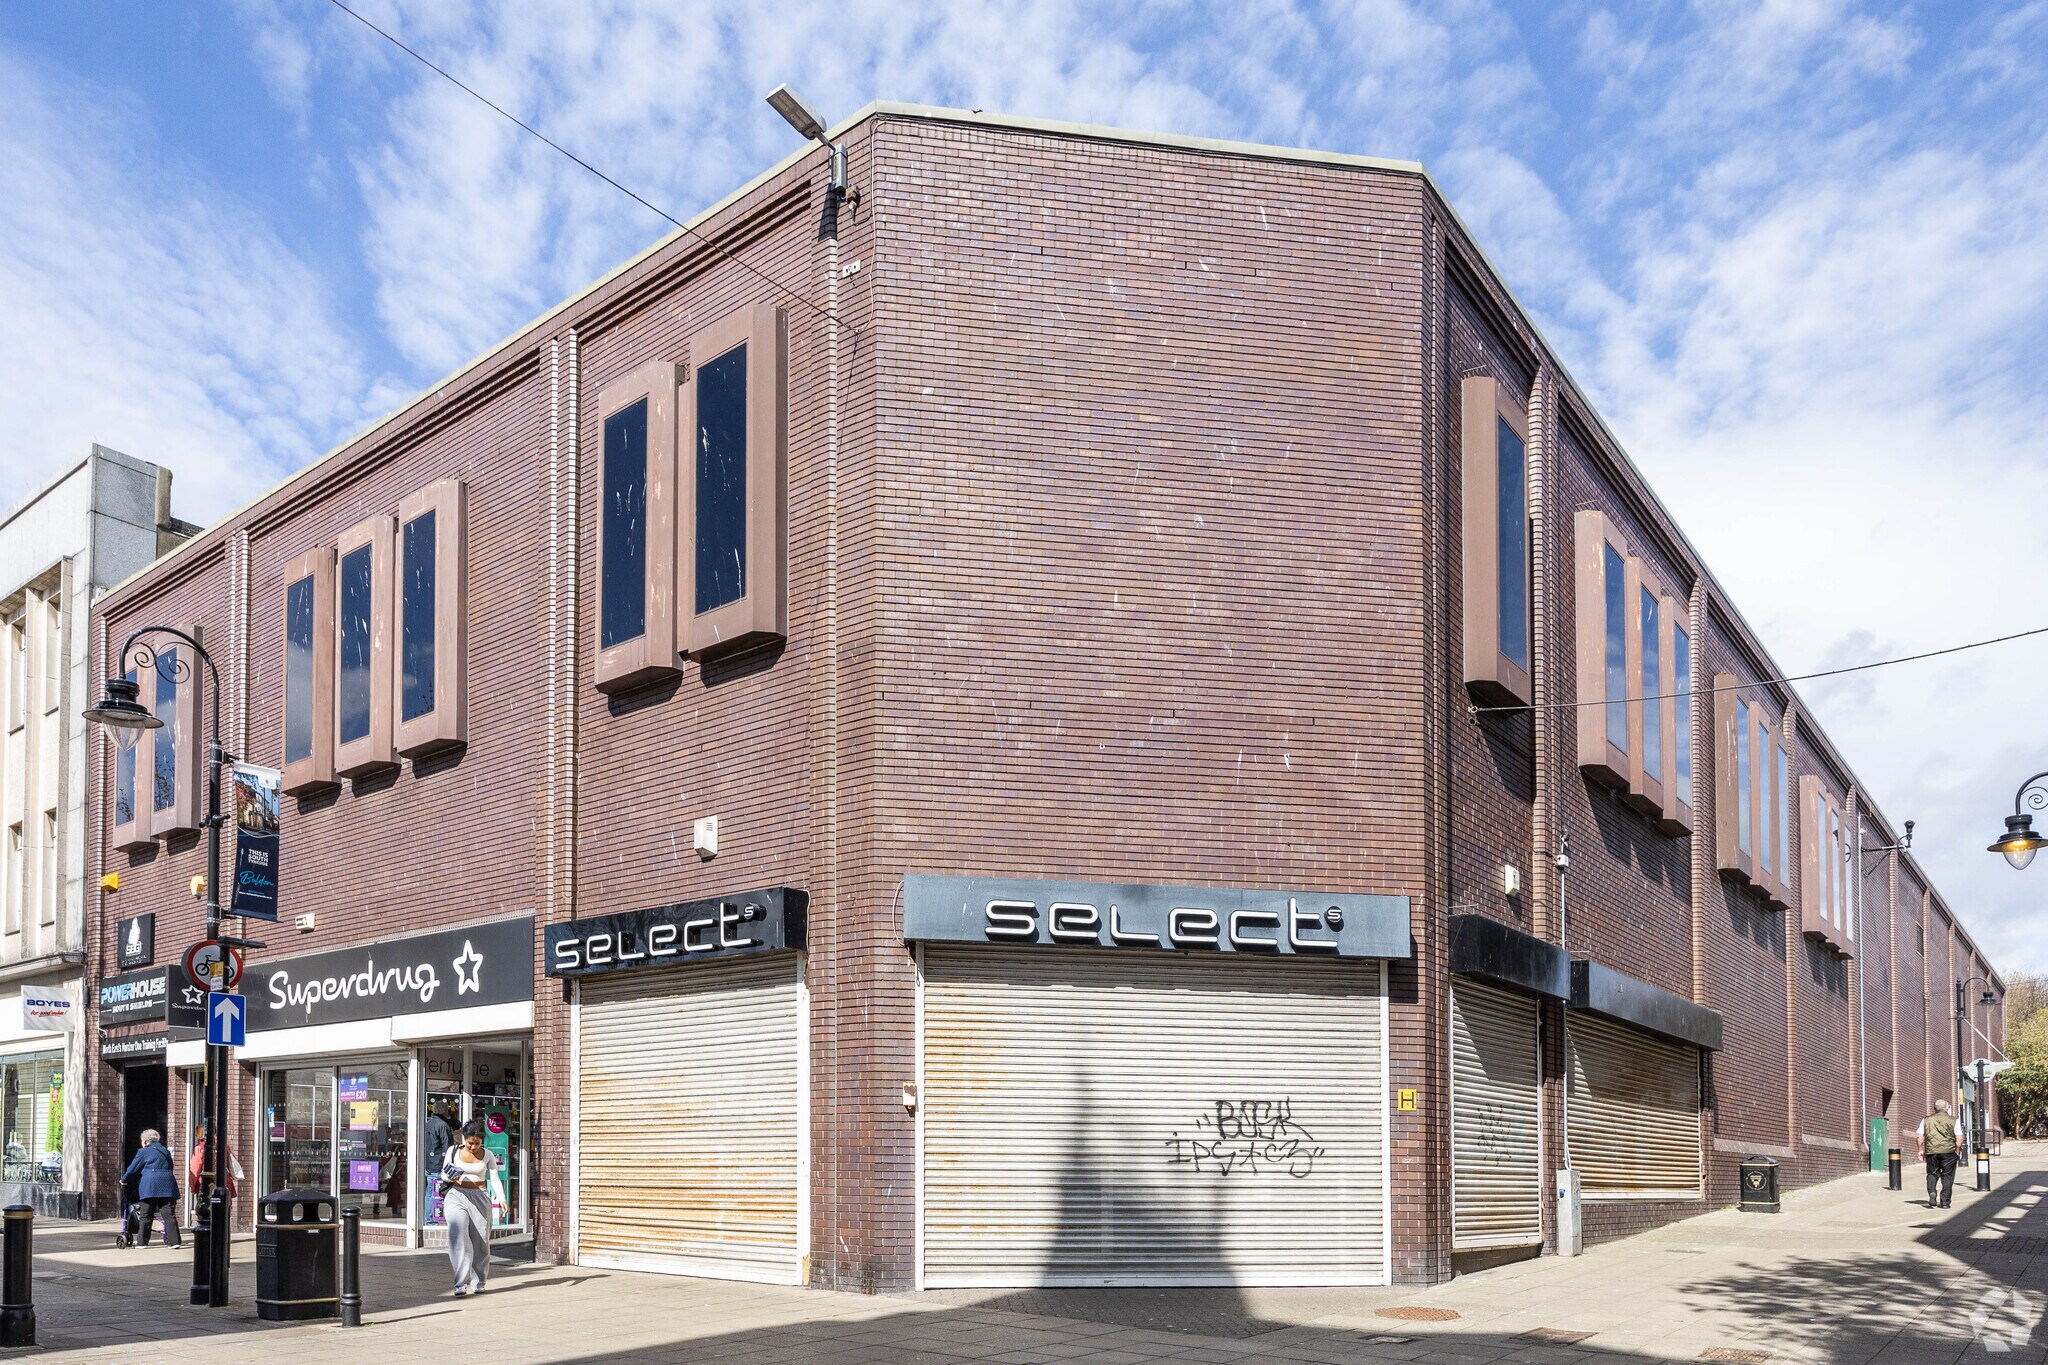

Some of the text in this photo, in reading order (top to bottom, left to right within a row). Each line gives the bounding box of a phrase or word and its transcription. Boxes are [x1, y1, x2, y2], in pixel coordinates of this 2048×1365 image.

[248, 849, 262, 857] THIS
[248, 854, 268, 863] SOUTH
[240, 871, 274, 887] Boldon
[101, 976, 166, 1005] POWERHOUSE
[268, 959, 441, 1014] Superdrug
[26, 999, 71, 1008] BOYES
[111, 999, 153, 1014] SOUTH SHIELDS
[171, 1002, 207, 1012] Superdr
[121, 1042, 135, 1052] Number
[134, 1041, 143, 1051] One
[142, 1039, 156, 1052] Training
[155, 1037, 168, 1049] Facility
[426, 1056, 490, 1077] erfue
[355, 1089, 367, 1100] £20
[1400, 1091, 1415, 1109] H
